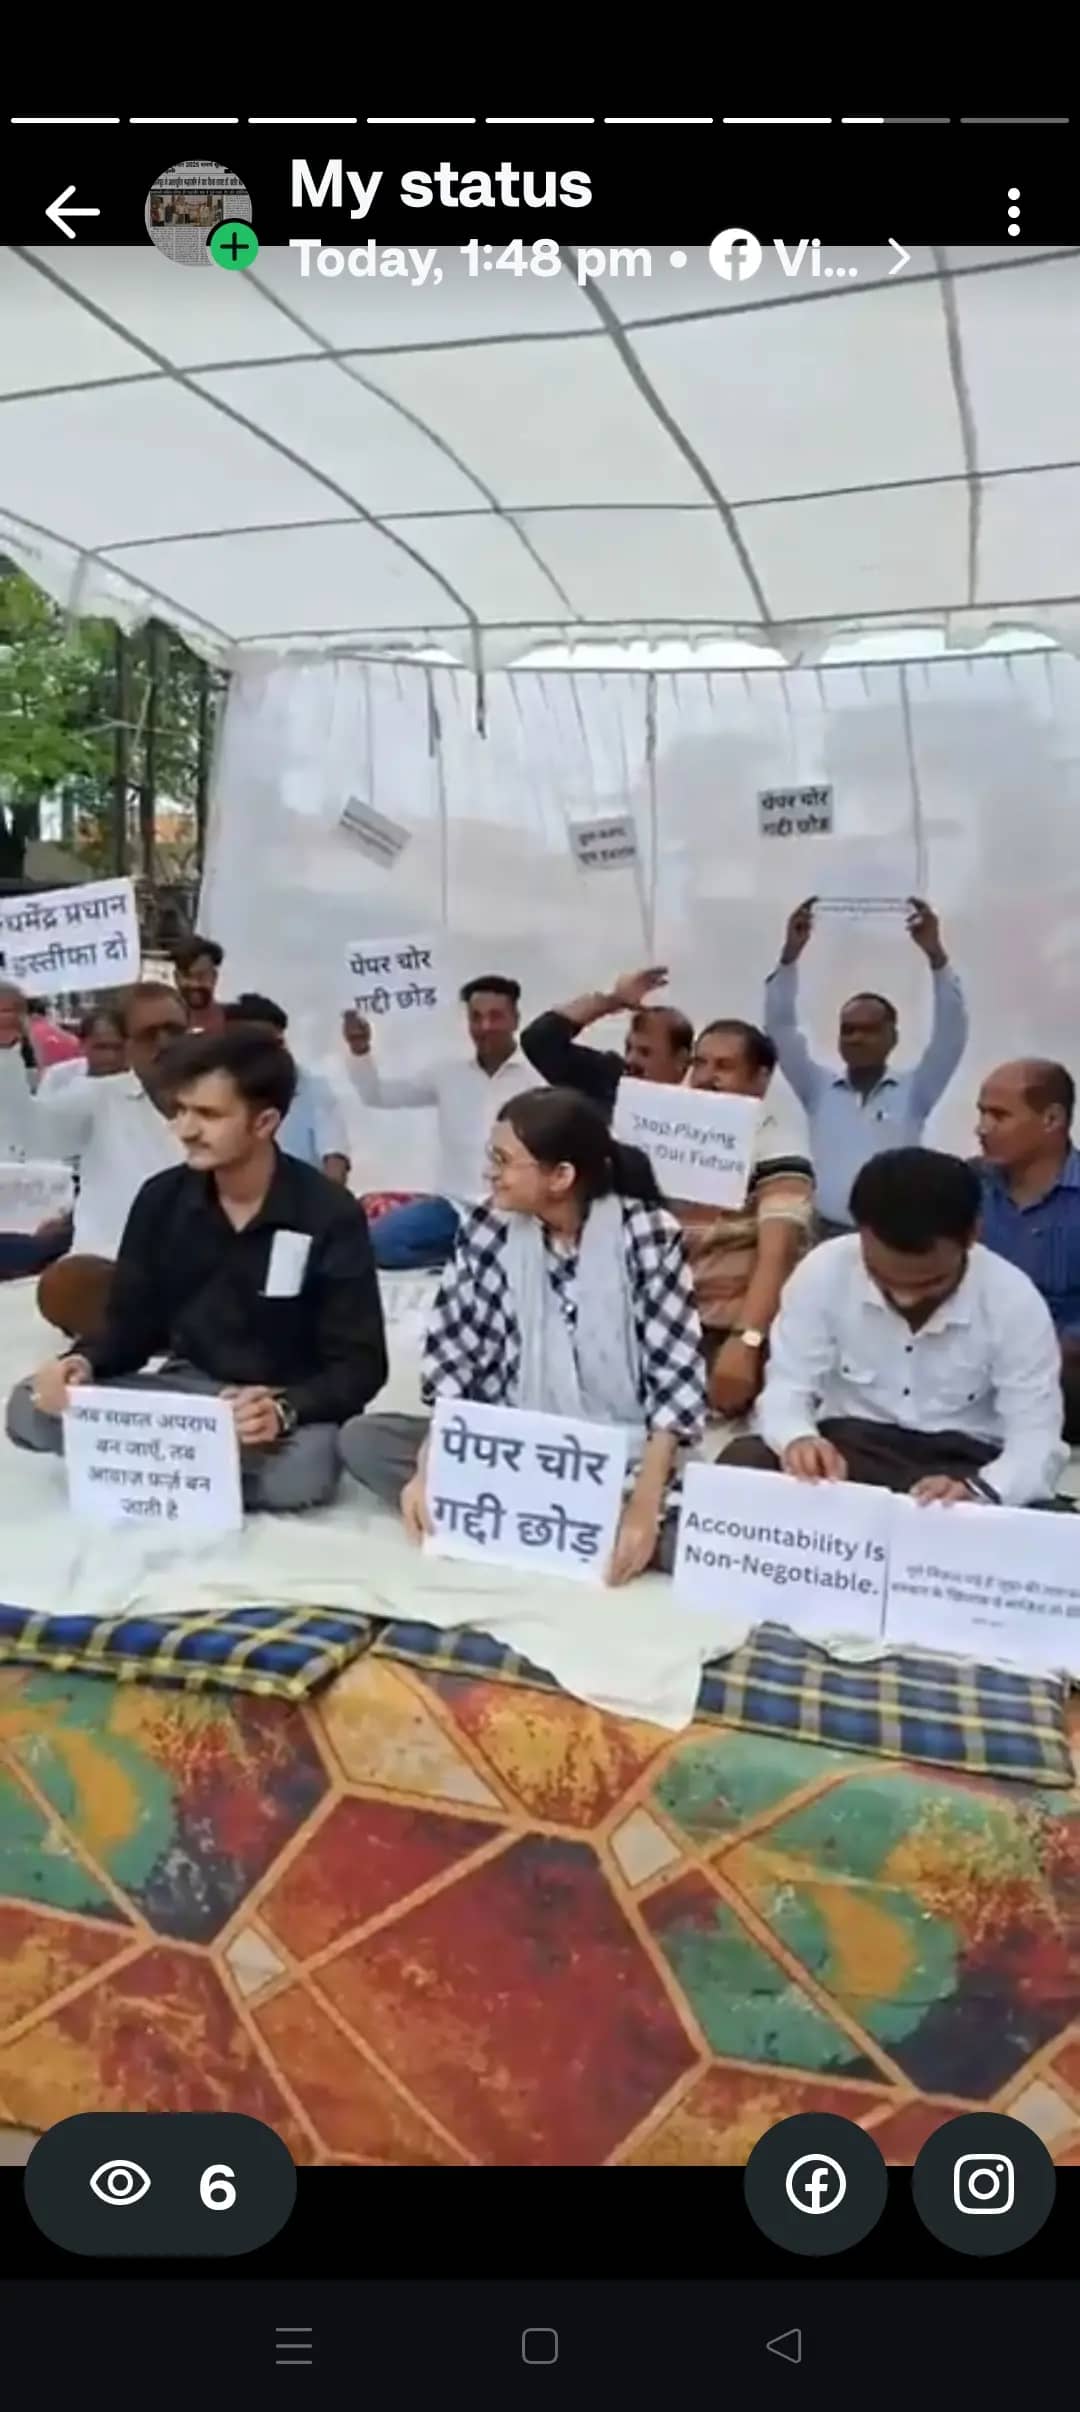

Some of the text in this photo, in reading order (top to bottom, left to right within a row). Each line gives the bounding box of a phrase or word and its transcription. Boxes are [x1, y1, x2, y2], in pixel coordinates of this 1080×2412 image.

[62, 894, 127, 924] प्रधान
[101, 931, 128, 961] दो
[350, 945, 432, 976] पेपर चोर
[674, 1122, 736, 1149] Playing
[690, 1149, 746, 1173] Future
[441, 1415, 610, 1485] पेपर चोर
[433, 1493, 603, 1563] गद्दी छोड़
[685, 1512, 886, 1562] Accountability Is
[684, 1545, 880, 1595] Non-Negotiable.
